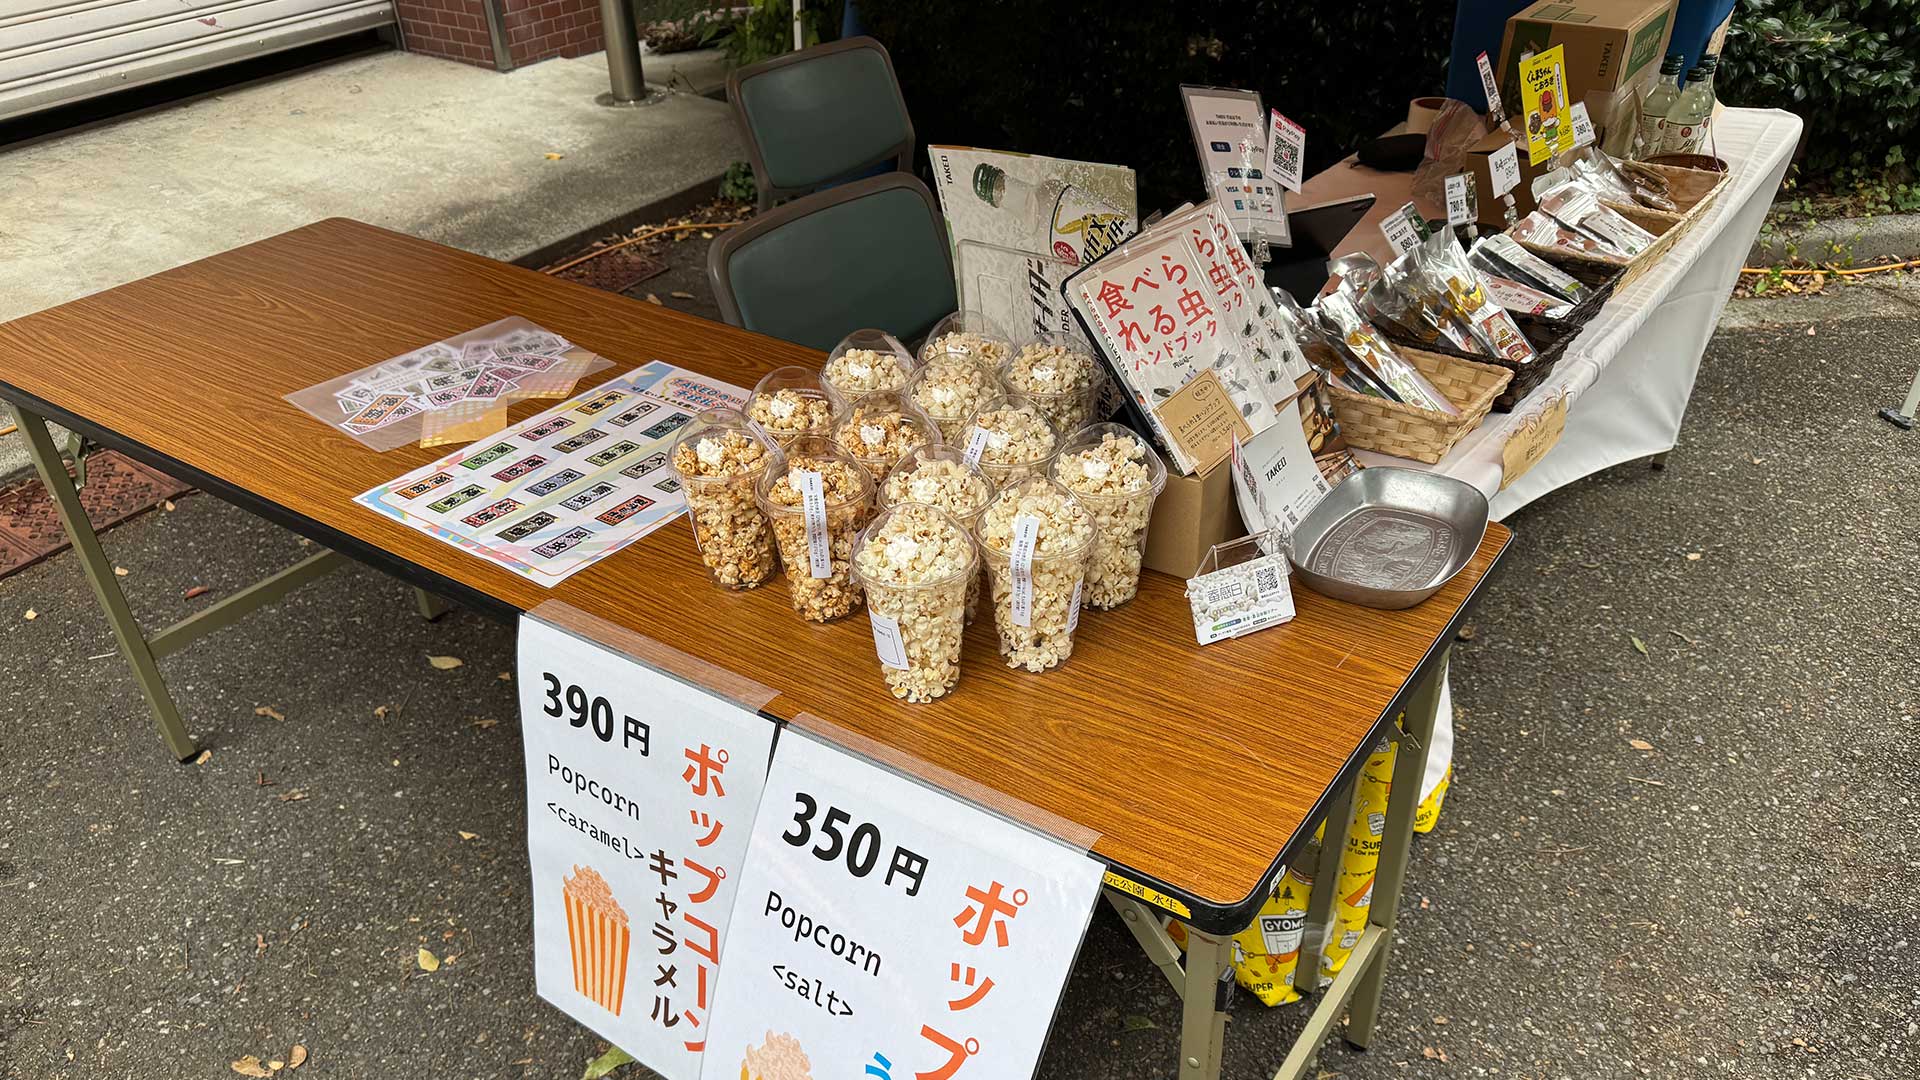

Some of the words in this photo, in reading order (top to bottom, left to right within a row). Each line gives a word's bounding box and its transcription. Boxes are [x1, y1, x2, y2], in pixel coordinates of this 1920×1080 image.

[941, 155, 953, 185] TAKEO
[1096, 255, 1188, 319] 食べら
[1117, 287, 1213, 352] れる虫
[1135, 320, 1217, 371] ハンドブック
[1265, 456, 1287, 482] TAKEO
[547, 753, 641, 821] Popcorn
[546, 800, 646, 862] <caramel>
[681, 742, 731, 1053] ポップコーン
[649, 848, 681, 1030] キャラメル
[764, 890, 882, 978] Popcorn
[772, 963, 854, 1019] <salt>
[914, 880, 1029, 1080] ポップ
